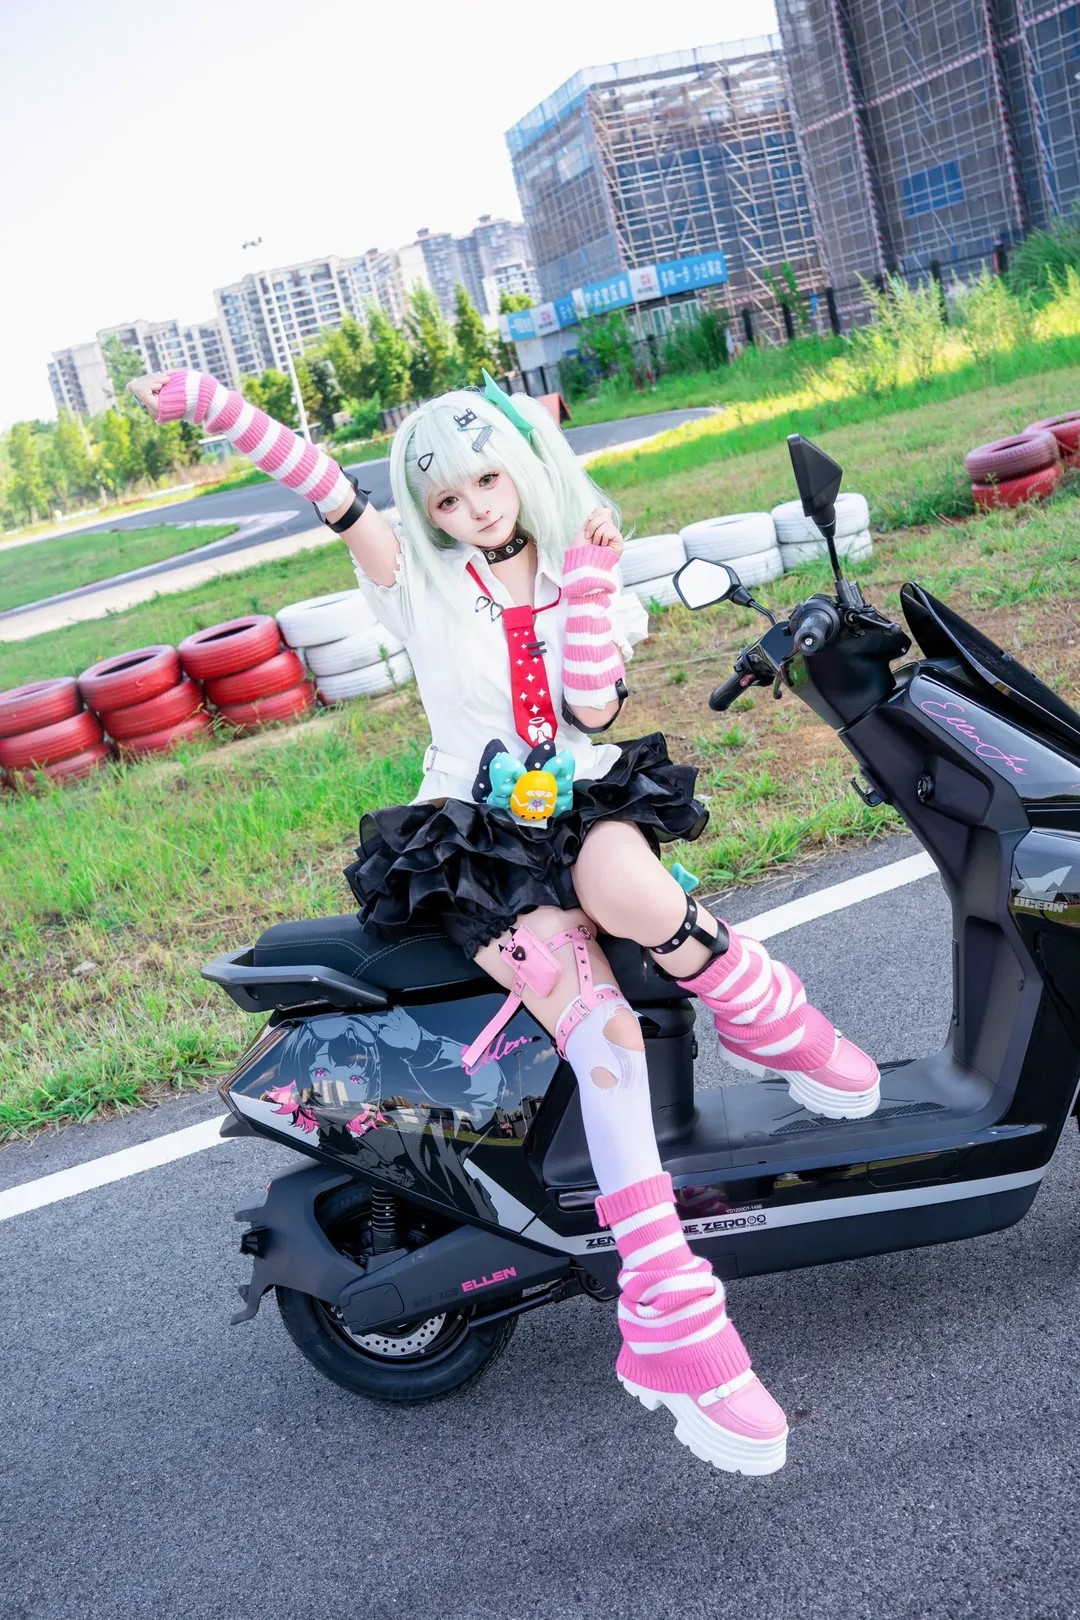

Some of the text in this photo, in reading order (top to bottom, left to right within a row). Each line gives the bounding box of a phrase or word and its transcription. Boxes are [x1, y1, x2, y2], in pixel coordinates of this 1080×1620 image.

[586, 1235, 616, 1248] ZEN
[682, 1223, 699, 1234] NE
[701, 1217, 747, 1231] ZERO
[461, 1266, 517, 1292] ELLEN
